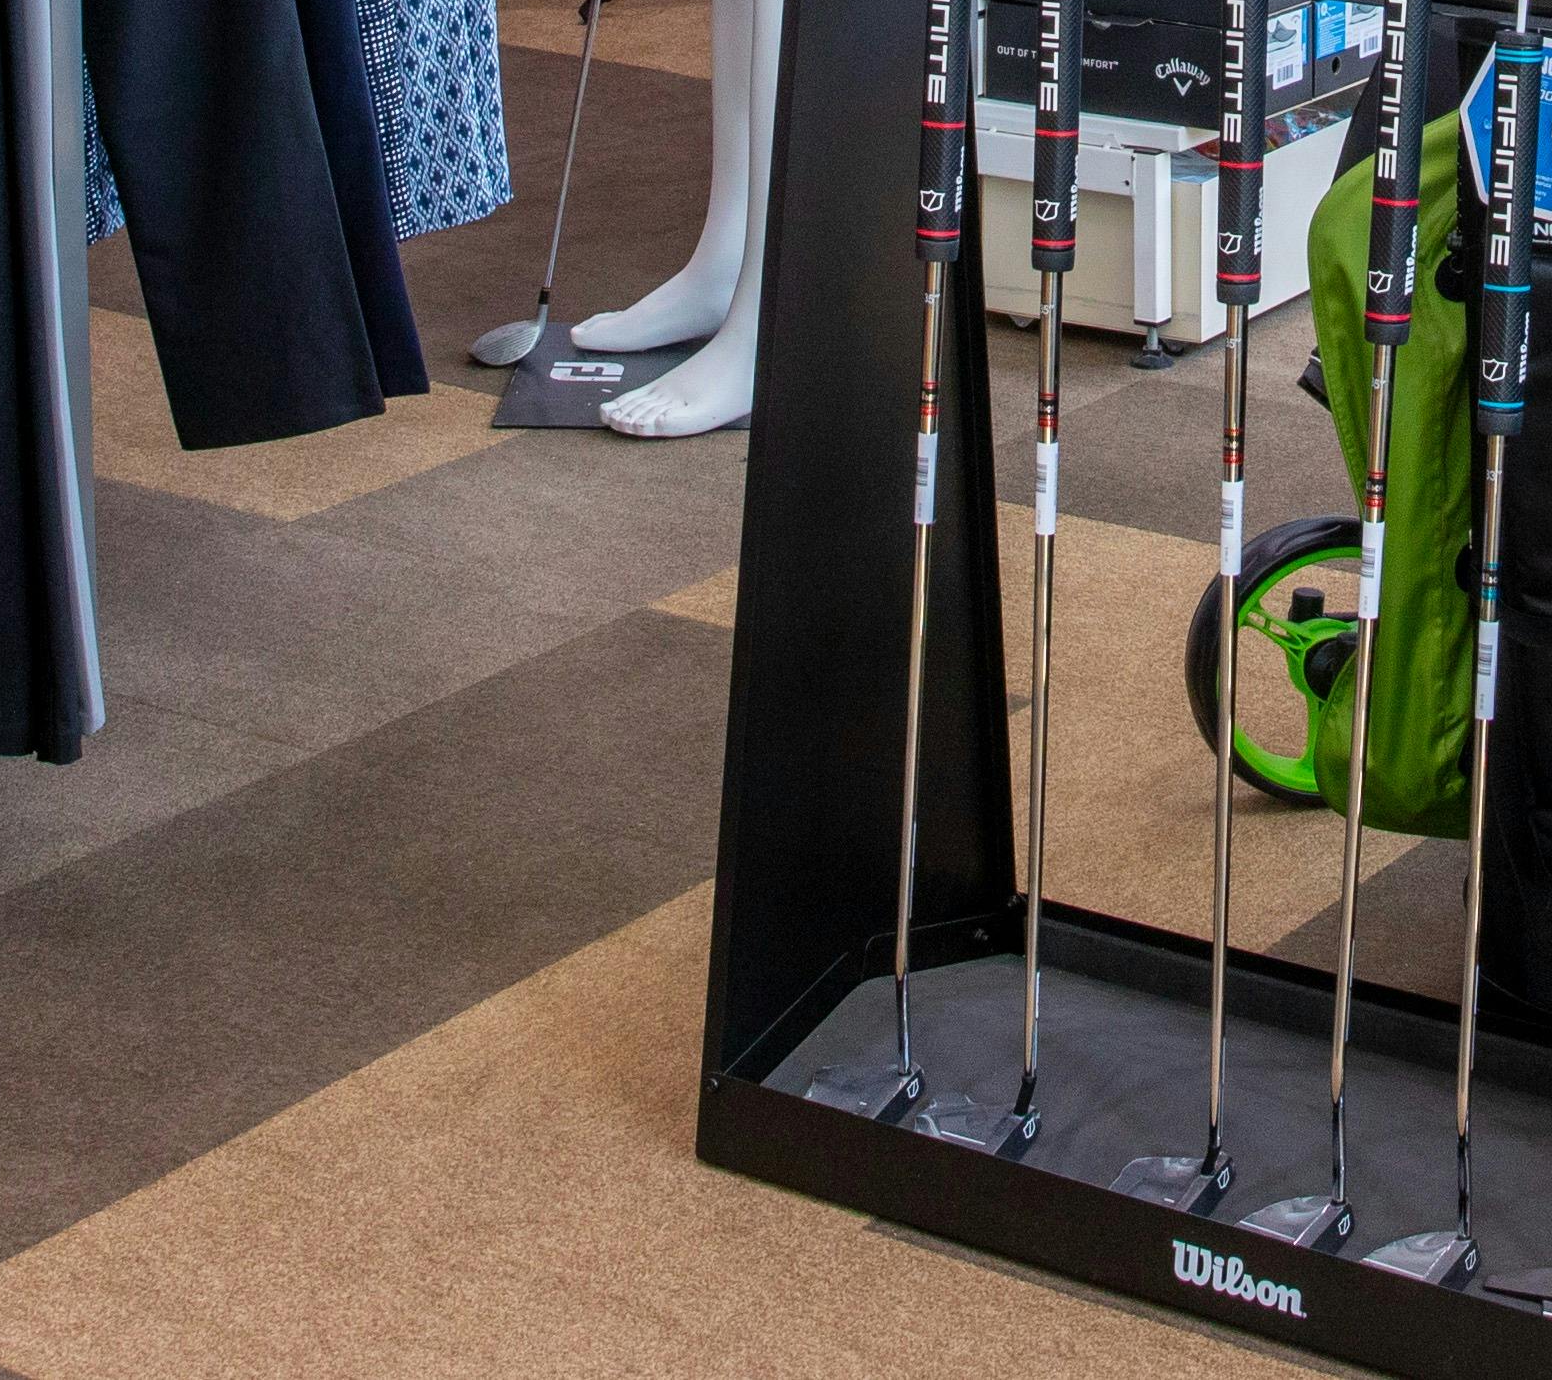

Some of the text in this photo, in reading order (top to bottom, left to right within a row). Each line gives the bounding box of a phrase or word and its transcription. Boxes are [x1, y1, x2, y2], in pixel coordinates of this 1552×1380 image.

[997, 45, 1029, 58] OUT OF
[1154, 56, 1211, 87] Callaway
[1490, 74, 1519, 267] INFINITE
[1172, 1239, 1306, 1319] Wilson
